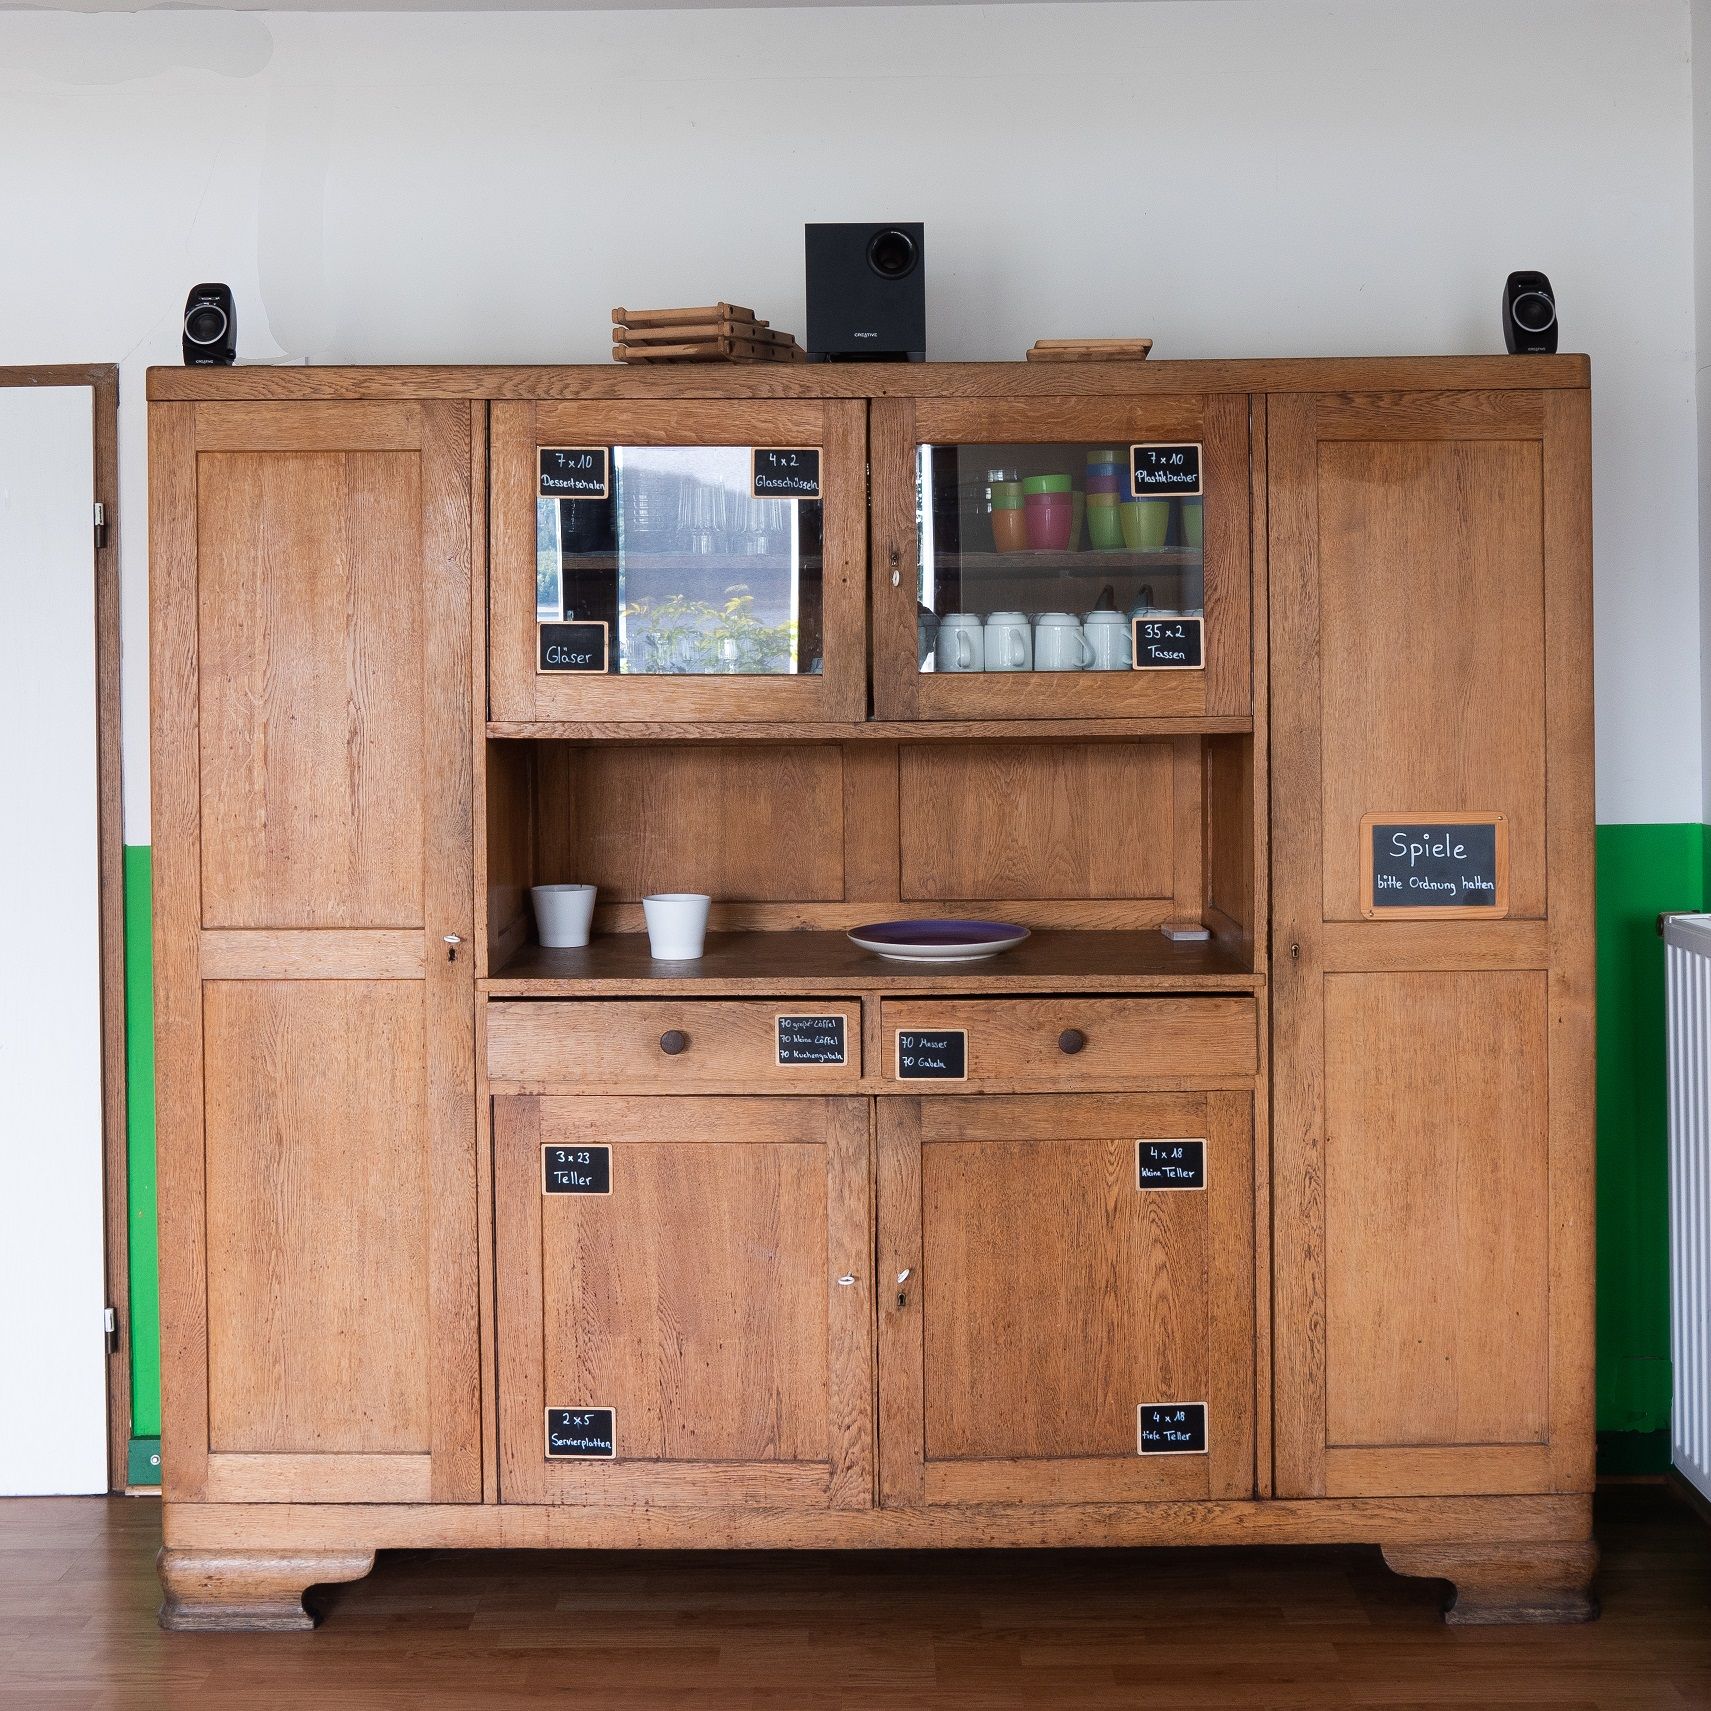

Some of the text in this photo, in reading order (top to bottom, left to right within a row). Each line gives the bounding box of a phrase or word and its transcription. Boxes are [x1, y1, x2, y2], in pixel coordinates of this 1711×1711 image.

[555, 453, 566, 468] 7
[577, 454, 593, 469] 10
[769, 453, 776, 467] 4
[790, 454, 800, 466] 2
[1147, 451, 1156, 464] 7
[1169, 453, 1184, 465] 10
[541, 473, 606, 491] Dessertschalen
[755, 474, 820, 491] Glasschüsseln
[1135, 469, 1198, 484] Plastikbecher
[1144, 623, 1162, 639] 35
[1175, 625, 1186, 638] 2
[546, 645, 593, 664] Gläser
[1147, 645, 1186, 660] Tassen
[1389, 832, 1468, 867] Spiele
[1377, 874, 1494, 896] bitte Ordnung halten
[779, 1018, 792, 1029] 70
[813, 1019, 836, 1029] Löffel
[779, 1034, 791, 1043] 70
[814, 1035, 838, 1046] Löffel
[900, 1036, 948, 1049] 70 Messer
[779, 1050, 844, 1063] 70 Kuchengabeln
[902, 1056, 947, 1069] 70 Gabeln
[555, 1150, 565, 1163] 3
[577, 1152, 590, 1164] 23
[1150, 1146, 1158, 1160] 4
[1171, 1147, 1183, 1158] 18
[553, 1171, 593, 1186] Teller
[1161, 1166, 1195, 1178] Teller
[562, 1412, 570, 1425] 2
[584, 1414, 595, 1426] 5
[1153, 1411, 1160, 1423] 4
[1174, 1410, 1185, 1422] 18
[551, 1432, 612, 1450] Servierplatten
[1142, 1430, 1192, 1441] tiefe Teller
